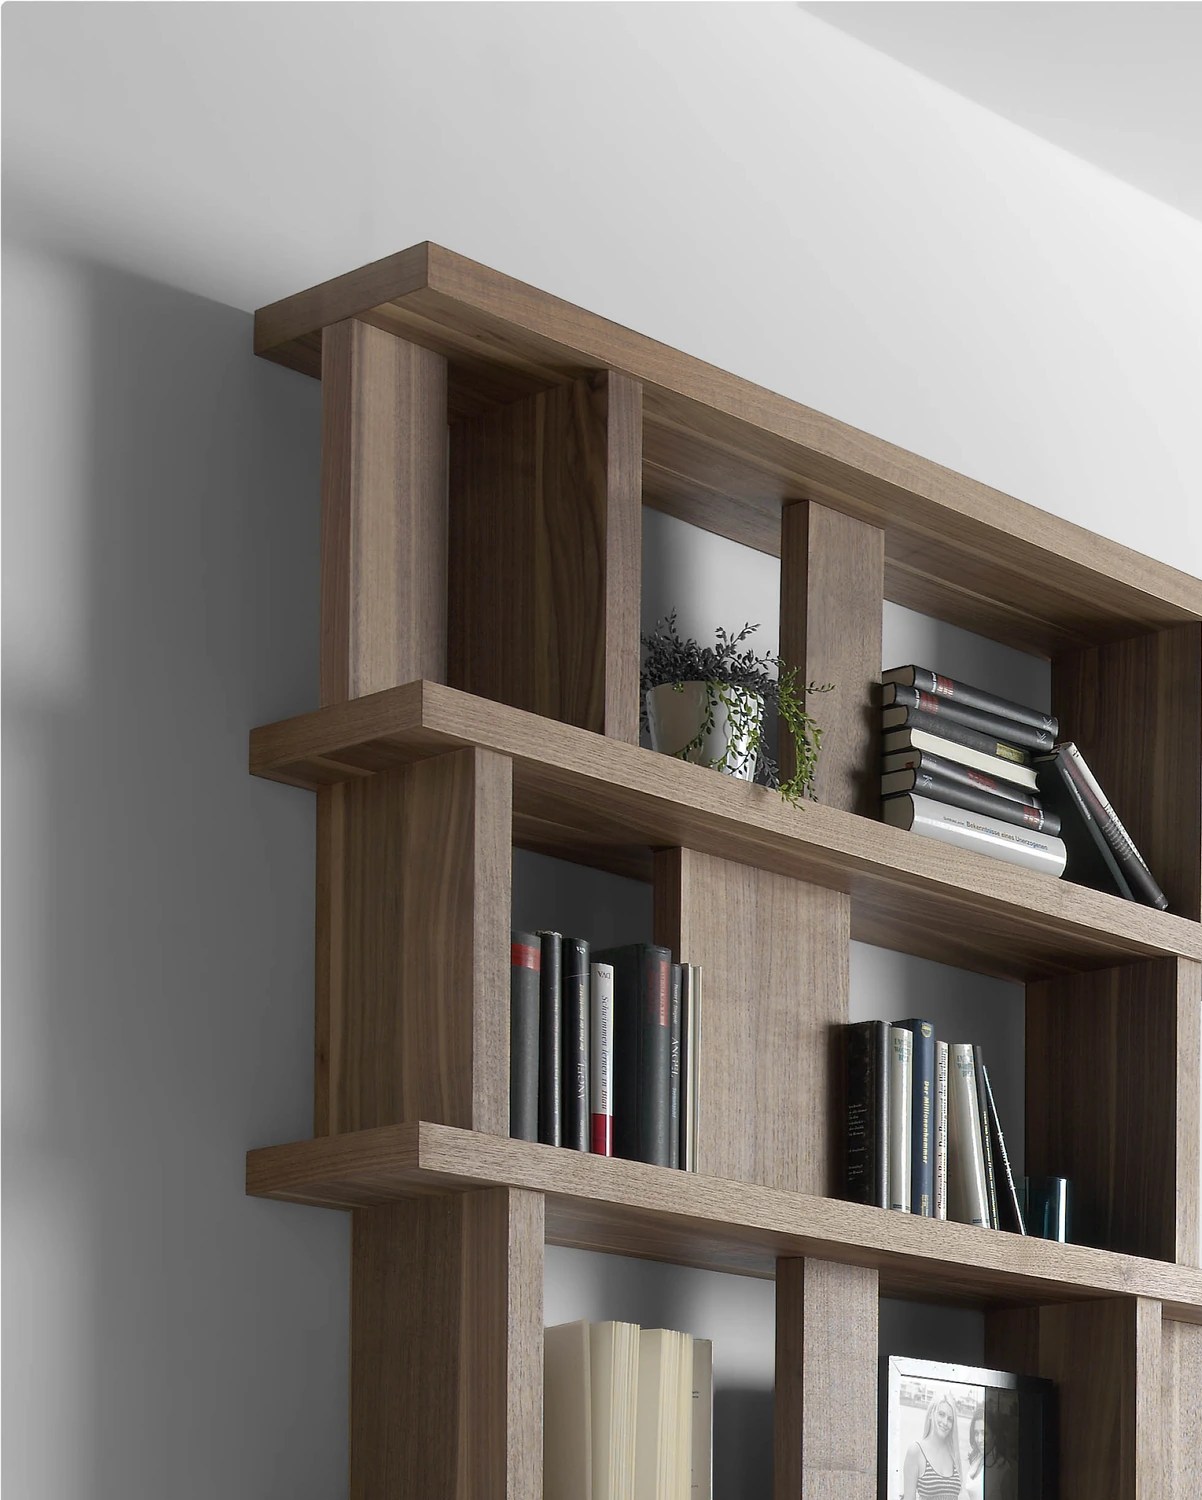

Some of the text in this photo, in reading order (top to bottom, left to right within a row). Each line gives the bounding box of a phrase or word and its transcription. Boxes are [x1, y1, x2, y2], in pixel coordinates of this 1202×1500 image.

[966, 820, 1000, 837] Bekenntnisse
[601, 995, 610, 1046] Schwimmen
[601, 1049, 610, 1075] lernen
[922, 1081, 930, 1164] Der Millionenhammer
